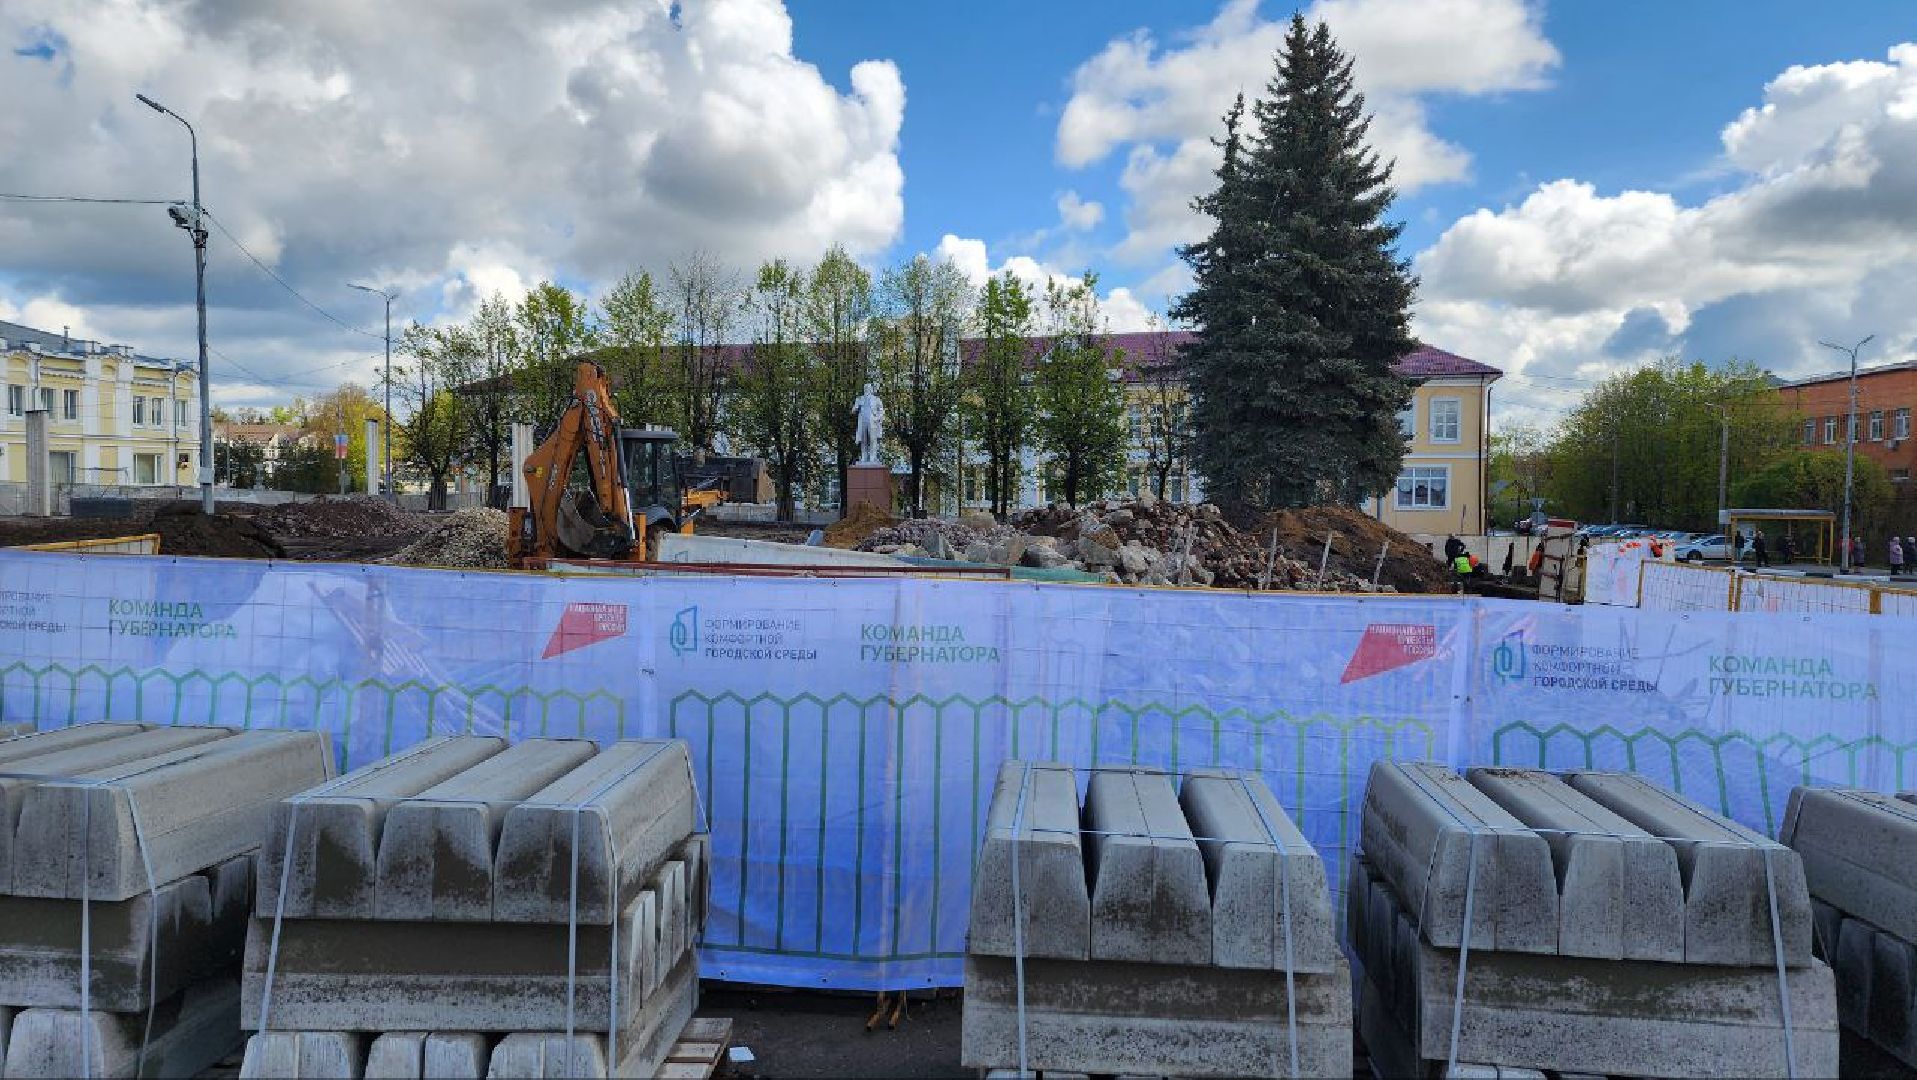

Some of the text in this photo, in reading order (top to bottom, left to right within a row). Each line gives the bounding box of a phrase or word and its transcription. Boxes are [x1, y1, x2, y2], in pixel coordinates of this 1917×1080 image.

[108, 599, 203, 619] КОМАНДА
[108, 619, 238, 639] ГУБЕРНАТОРА
[861, 623, 965, 643] КОМАНДА
[705, 647, 817, 661] ГОРОДСКОЙ СРЕДЫ
[860, 644, 1001, 663] ГУБЕРНАТОРА
[1709, 655, 1834, 678] КОМАНДА
[1534, 676, 1658, 693] ГОРОДСКОЙ СРЕДЫ
[1709, 677, 1879, 701] ГУБЕРНАТОРА
